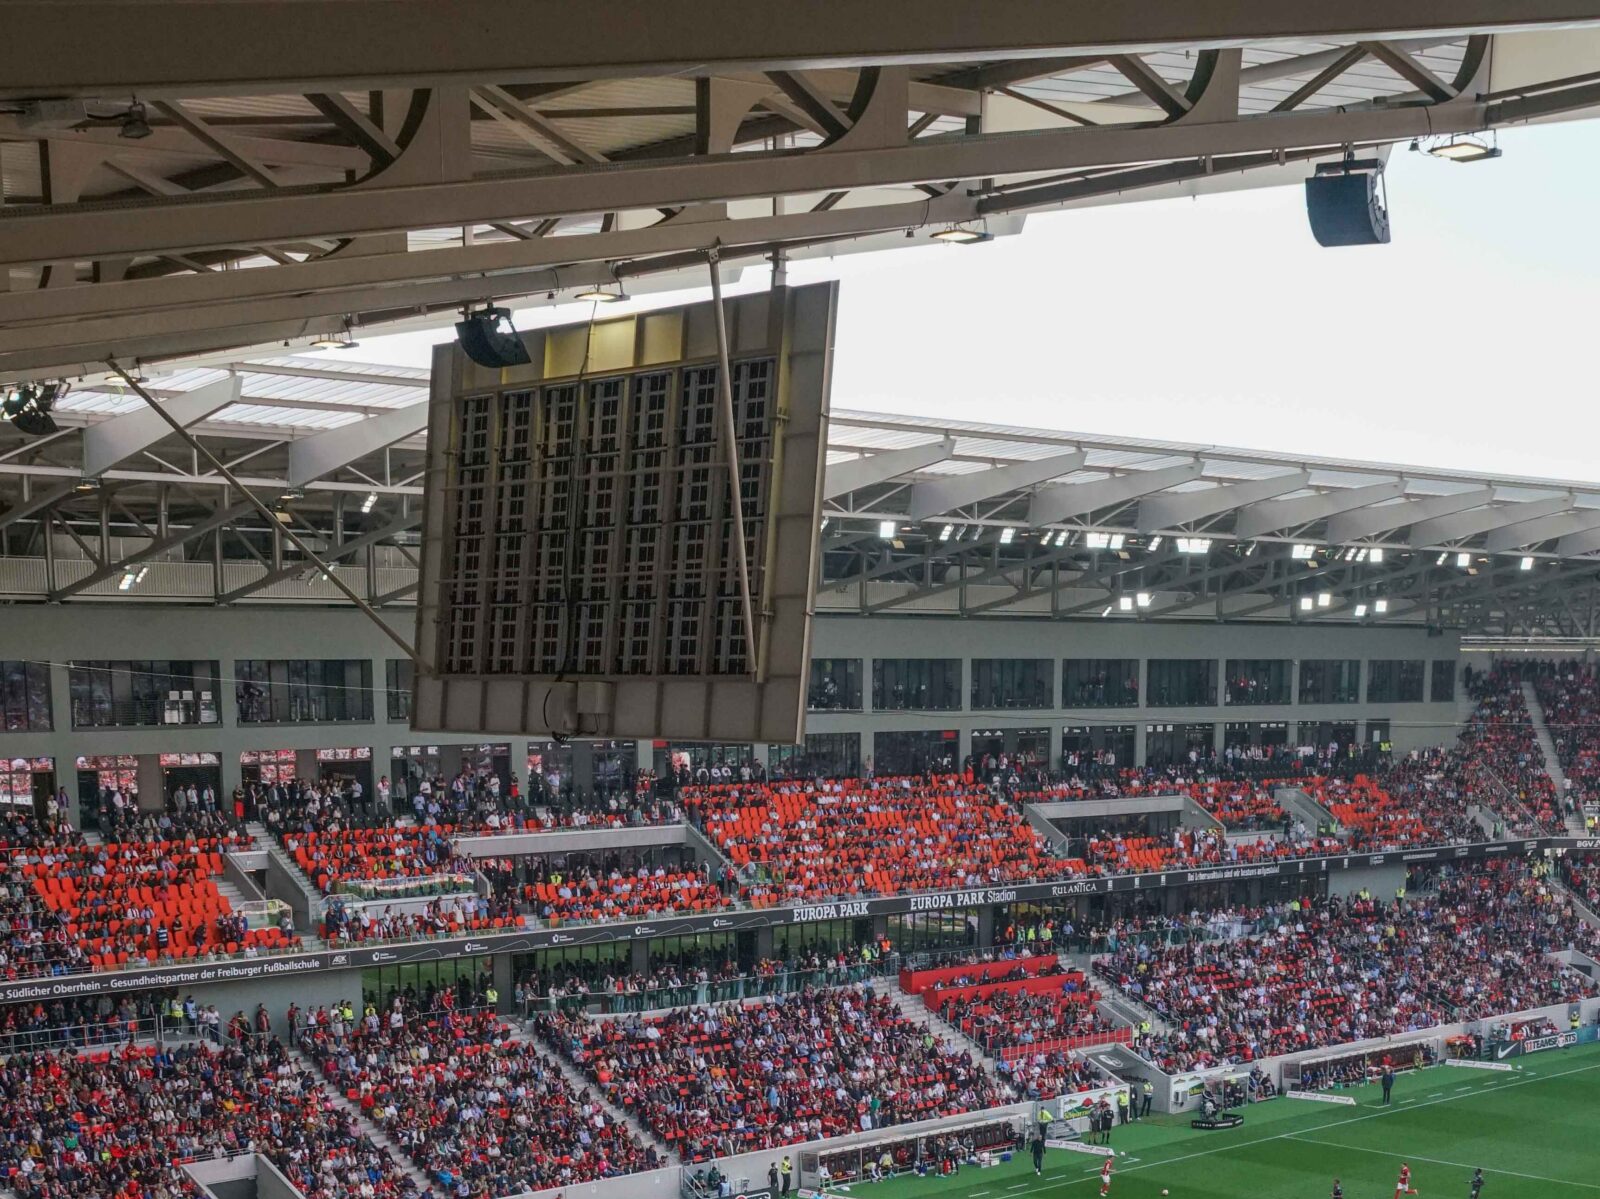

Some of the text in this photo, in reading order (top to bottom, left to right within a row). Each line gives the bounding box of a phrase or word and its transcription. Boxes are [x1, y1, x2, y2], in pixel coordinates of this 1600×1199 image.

[1052, 882, 1097, 896] RULANTICA
[910, 889, 1017, 910] EUROPA PARK Stadion
[793, 902, 869, 921] EUROPA PARK
[6, 987, 51, 999] Südlicher
[53, 981, 100, 994] Oberrhein
[110, 972, 199, 988] Gesundheitspartner
[200, 969, 216, 979] der
[217, 965, 262, 978] Freiburger
[263, 958, 320, 973] Fußballschule
